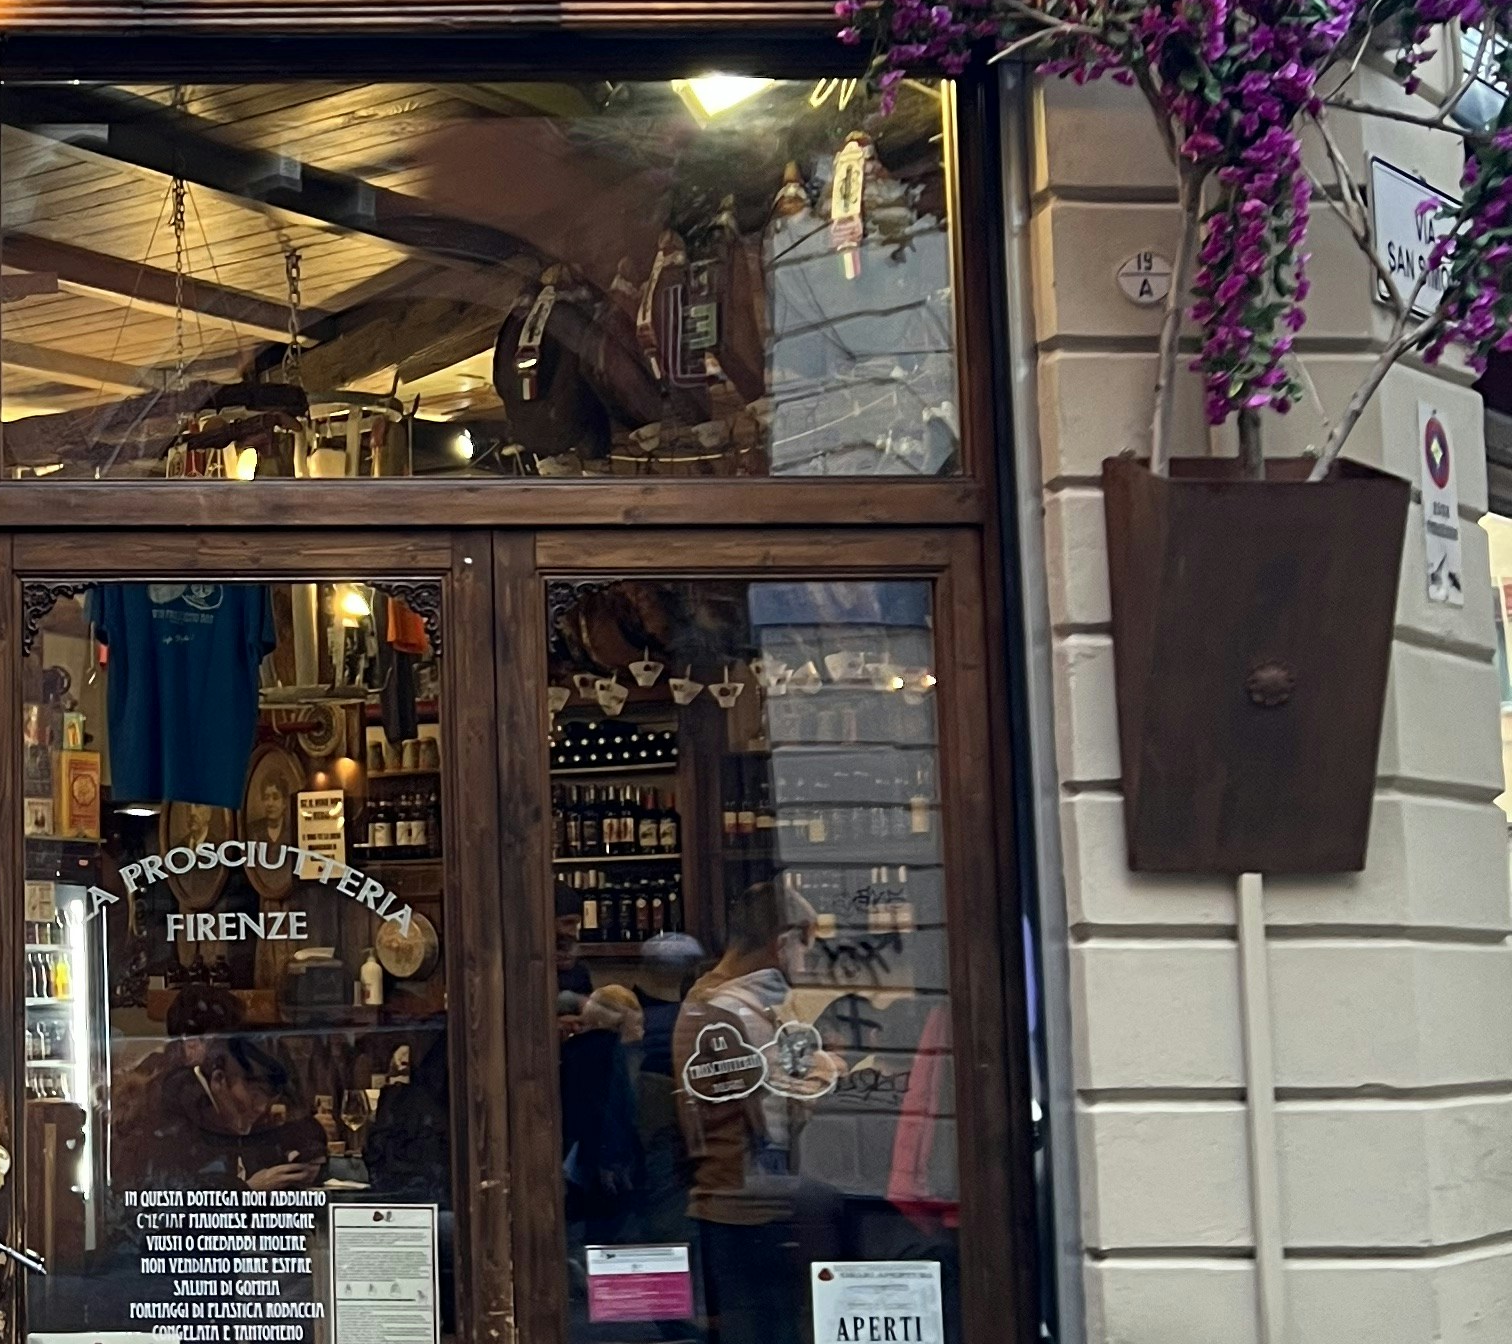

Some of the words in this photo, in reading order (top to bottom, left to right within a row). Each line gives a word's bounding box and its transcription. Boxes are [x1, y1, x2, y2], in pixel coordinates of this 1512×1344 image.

[1137, 253, 1153, 271] 19
[1388, 241, 1416, 280] SAN
[1138, 278, 1154, 299] A
[118, 840, 413, 939] PROSCIUTTERIA
[166, 911, 308, 942] FIRENZE
[124, 1191, 138, 1207] IN
[140, 1191, 184, 1207] QUESTA
[187, 1191, 239, 1207] BOTTEGA
[242, 1191, 267, 1206] NON
[270, 1191, 327, 1207] ABBIAMO
[189, 1213, 248, 1229] MAIONESE
[251, 1213, 315, 1229] AMBURGHE
[185, 1235, 195, 1251] O
[259, 1235, 307, 1251] INOLTRE
[141, 1258, 166, 1273] NON
[169, 1258, 231, 1274] VENDIAMO
[233, 1258, 269, 1274] BIRRE
[173, 1280, 218, 1296] SALUMI
[220, 1280, 233, 1295] DI
[236, 1280, 281, 1296] GOMMA
[130, 1302, 189, 1318] FORMAGGI
[192, 1303, 204, 1318] DI
[207, 1302, 263, 1318] PLASTICA
[266, 1302, 325, 1318] ROBACCIA
[152, 1325, 220, 1341] CONGELATA
[223, 1325, 231, 1340] E
[233, 1325, 304, 1341] TANTOMENO
[836, 1316, 923, 1342] APERTI
